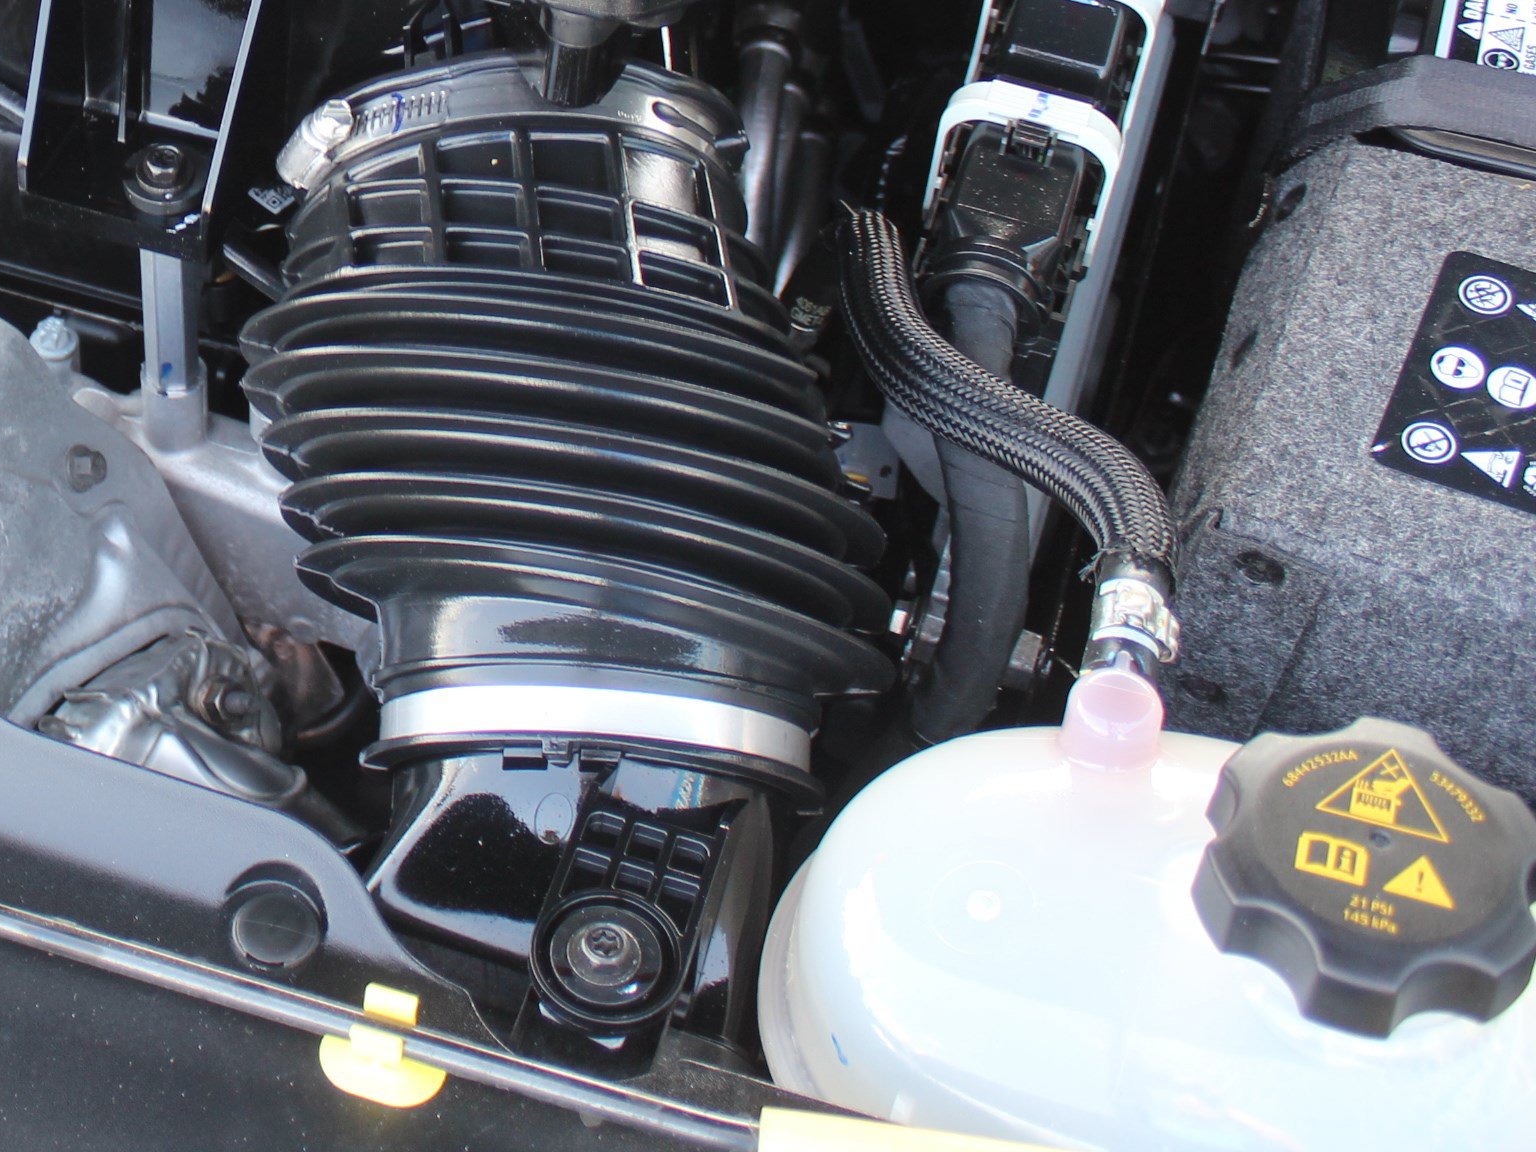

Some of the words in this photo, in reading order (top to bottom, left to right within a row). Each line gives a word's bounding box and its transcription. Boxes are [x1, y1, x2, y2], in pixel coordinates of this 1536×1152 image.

[1506, 3, 1518, 15] NO
[1523, 45, 1536, 70] GASES
[1350, 894, 1367, 909] 21
[1371, 899, 1395, 916] PSI
[1344, 909, 1367, 925] 145
[1372, 913, 1398, 934] kPa
